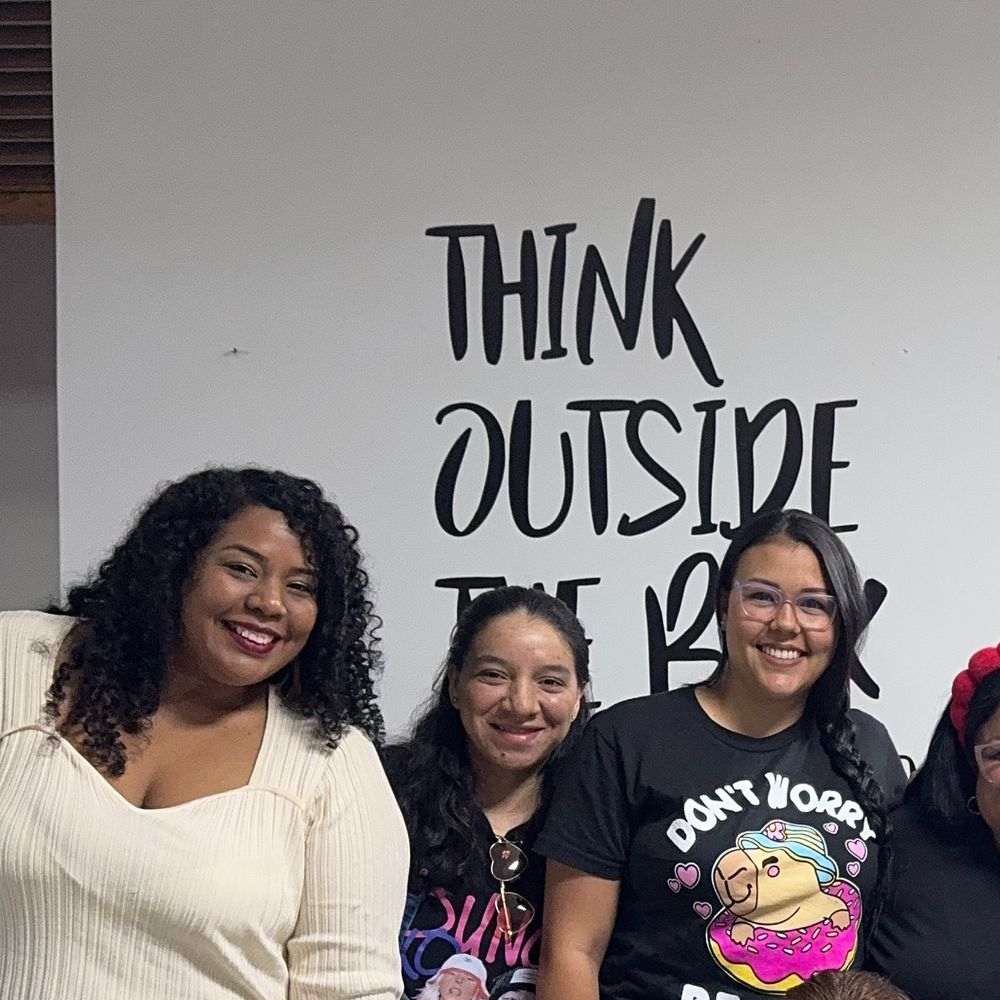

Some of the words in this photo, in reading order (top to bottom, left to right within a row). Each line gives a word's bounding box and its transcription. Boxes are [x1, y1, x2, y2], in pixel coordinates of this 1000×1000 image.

[425, 197, 724, 387] THINK
[434, 398, 859, 539] OUTSIDE
[666, 779, 761, 853] DON'T
[764, 772, 877, 842] WORRY
